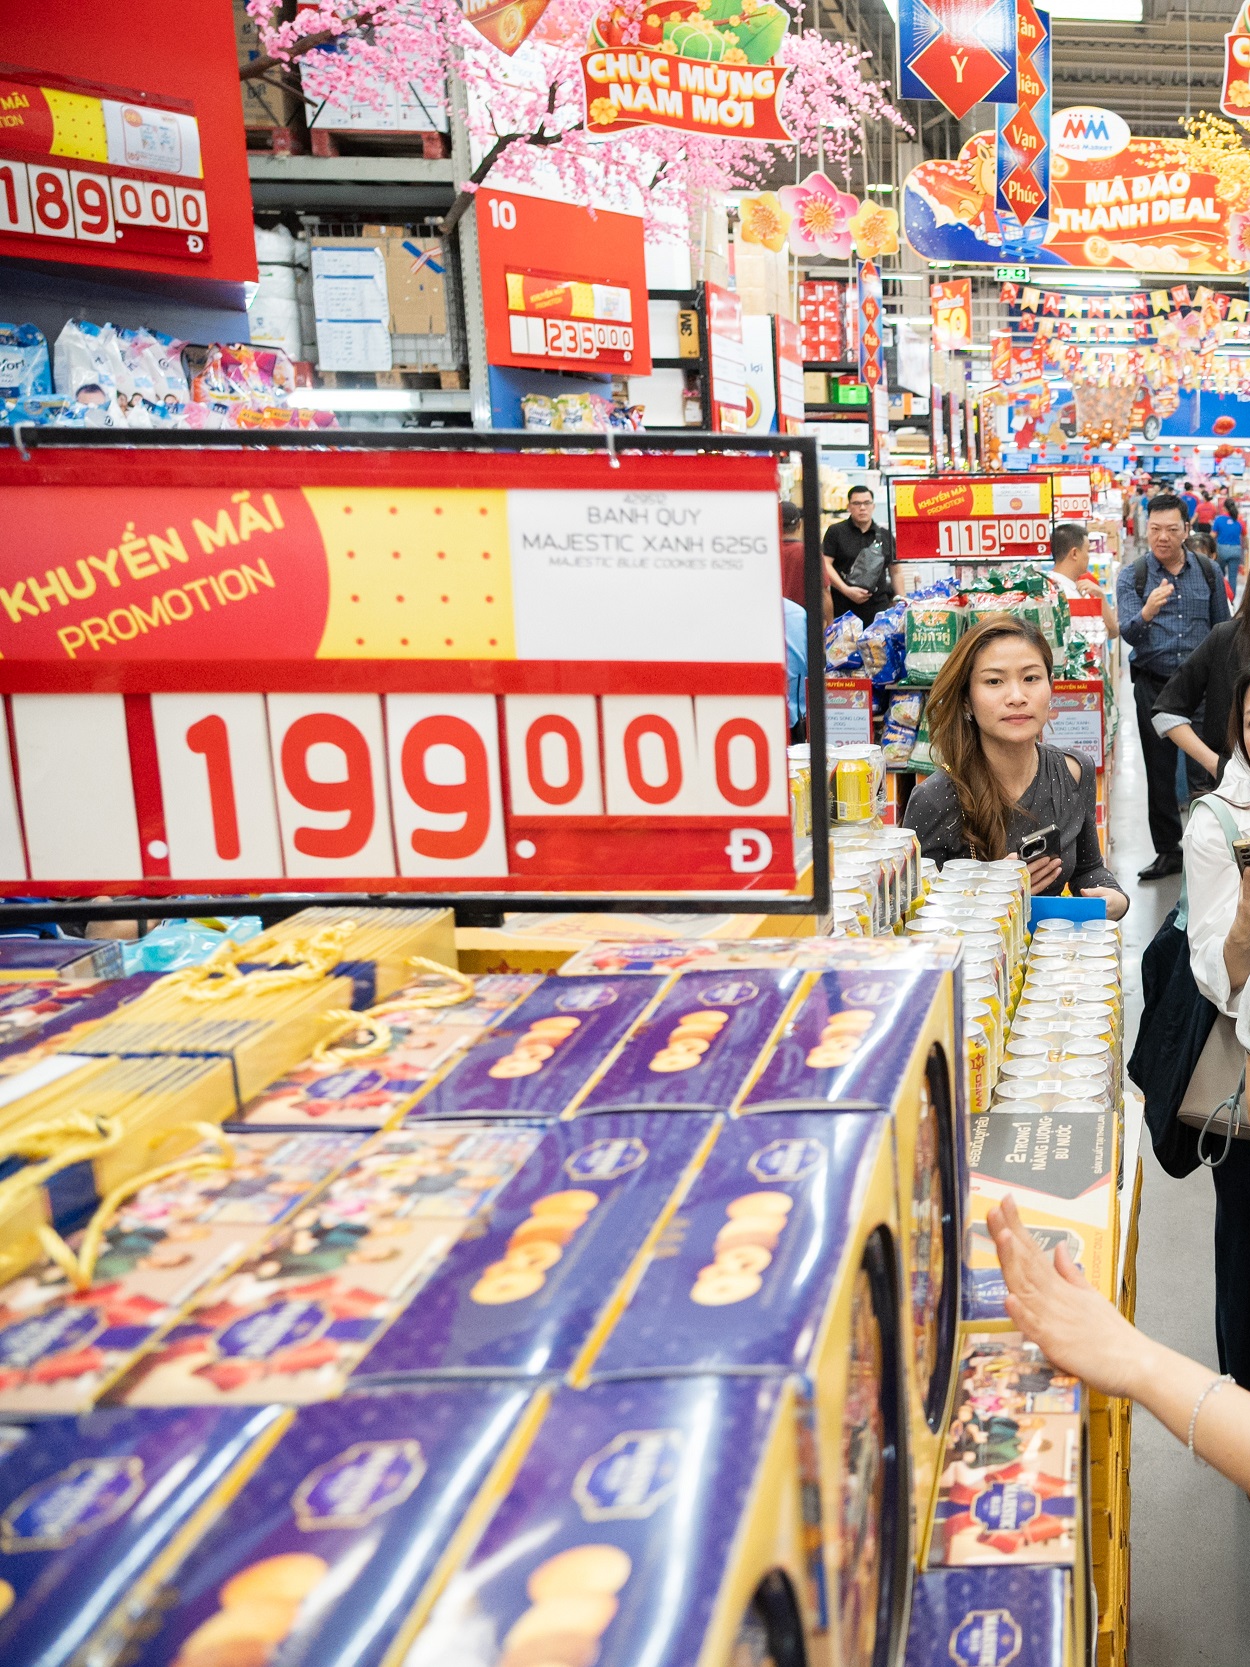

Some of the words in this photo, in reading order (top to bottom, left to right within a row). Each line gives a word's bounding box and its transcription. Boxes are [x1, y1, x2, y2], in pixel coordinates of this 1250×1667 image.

[586, 50, 670, 86] CHÚC
[678, 63, 776, 100] MỪNG
[950, 47, 968, 84] Ý
[1018, 76, 1040, 97] iên
[609, 82, 684, 119] NĂM
[692, 96, 755, 128] MỚI
[1012, 125, 1037, 152] Vạn
[1008, 182, 1038, 205] Phúc
[488, 198, 518, 230] 10
[1054, 200, 1150, 233] THÀNH
[1151, 197, 1221, 223] DEAL
[680, 312, 693, 337] 3M
[918, 489, 952, 510] KHUYẾN
[951, 484, 967, 498] MÃI
[927, 496, 965, 516] PROMOTION
[586, 505, 650, 525] BANH
[656, 506, 702, 526] QUY
[1, 519, 181, 625] KHUYẾN
[192, 488, 287, 551] MÃI
[521, 533, 634, 553] MAJESTIC
[642, 535, 705, 553] XANH
[711, 536, 769, 556] 625G
[56, 556, 277, 659] PROMOTION
[724, 827, 775, 875] Đ
[1055, 1124, 1073, 1147] NƯỚC
[1031, 1145, 1048, 1171] NĂNG
[1052, 1147, 1070, 1161] BÙ
